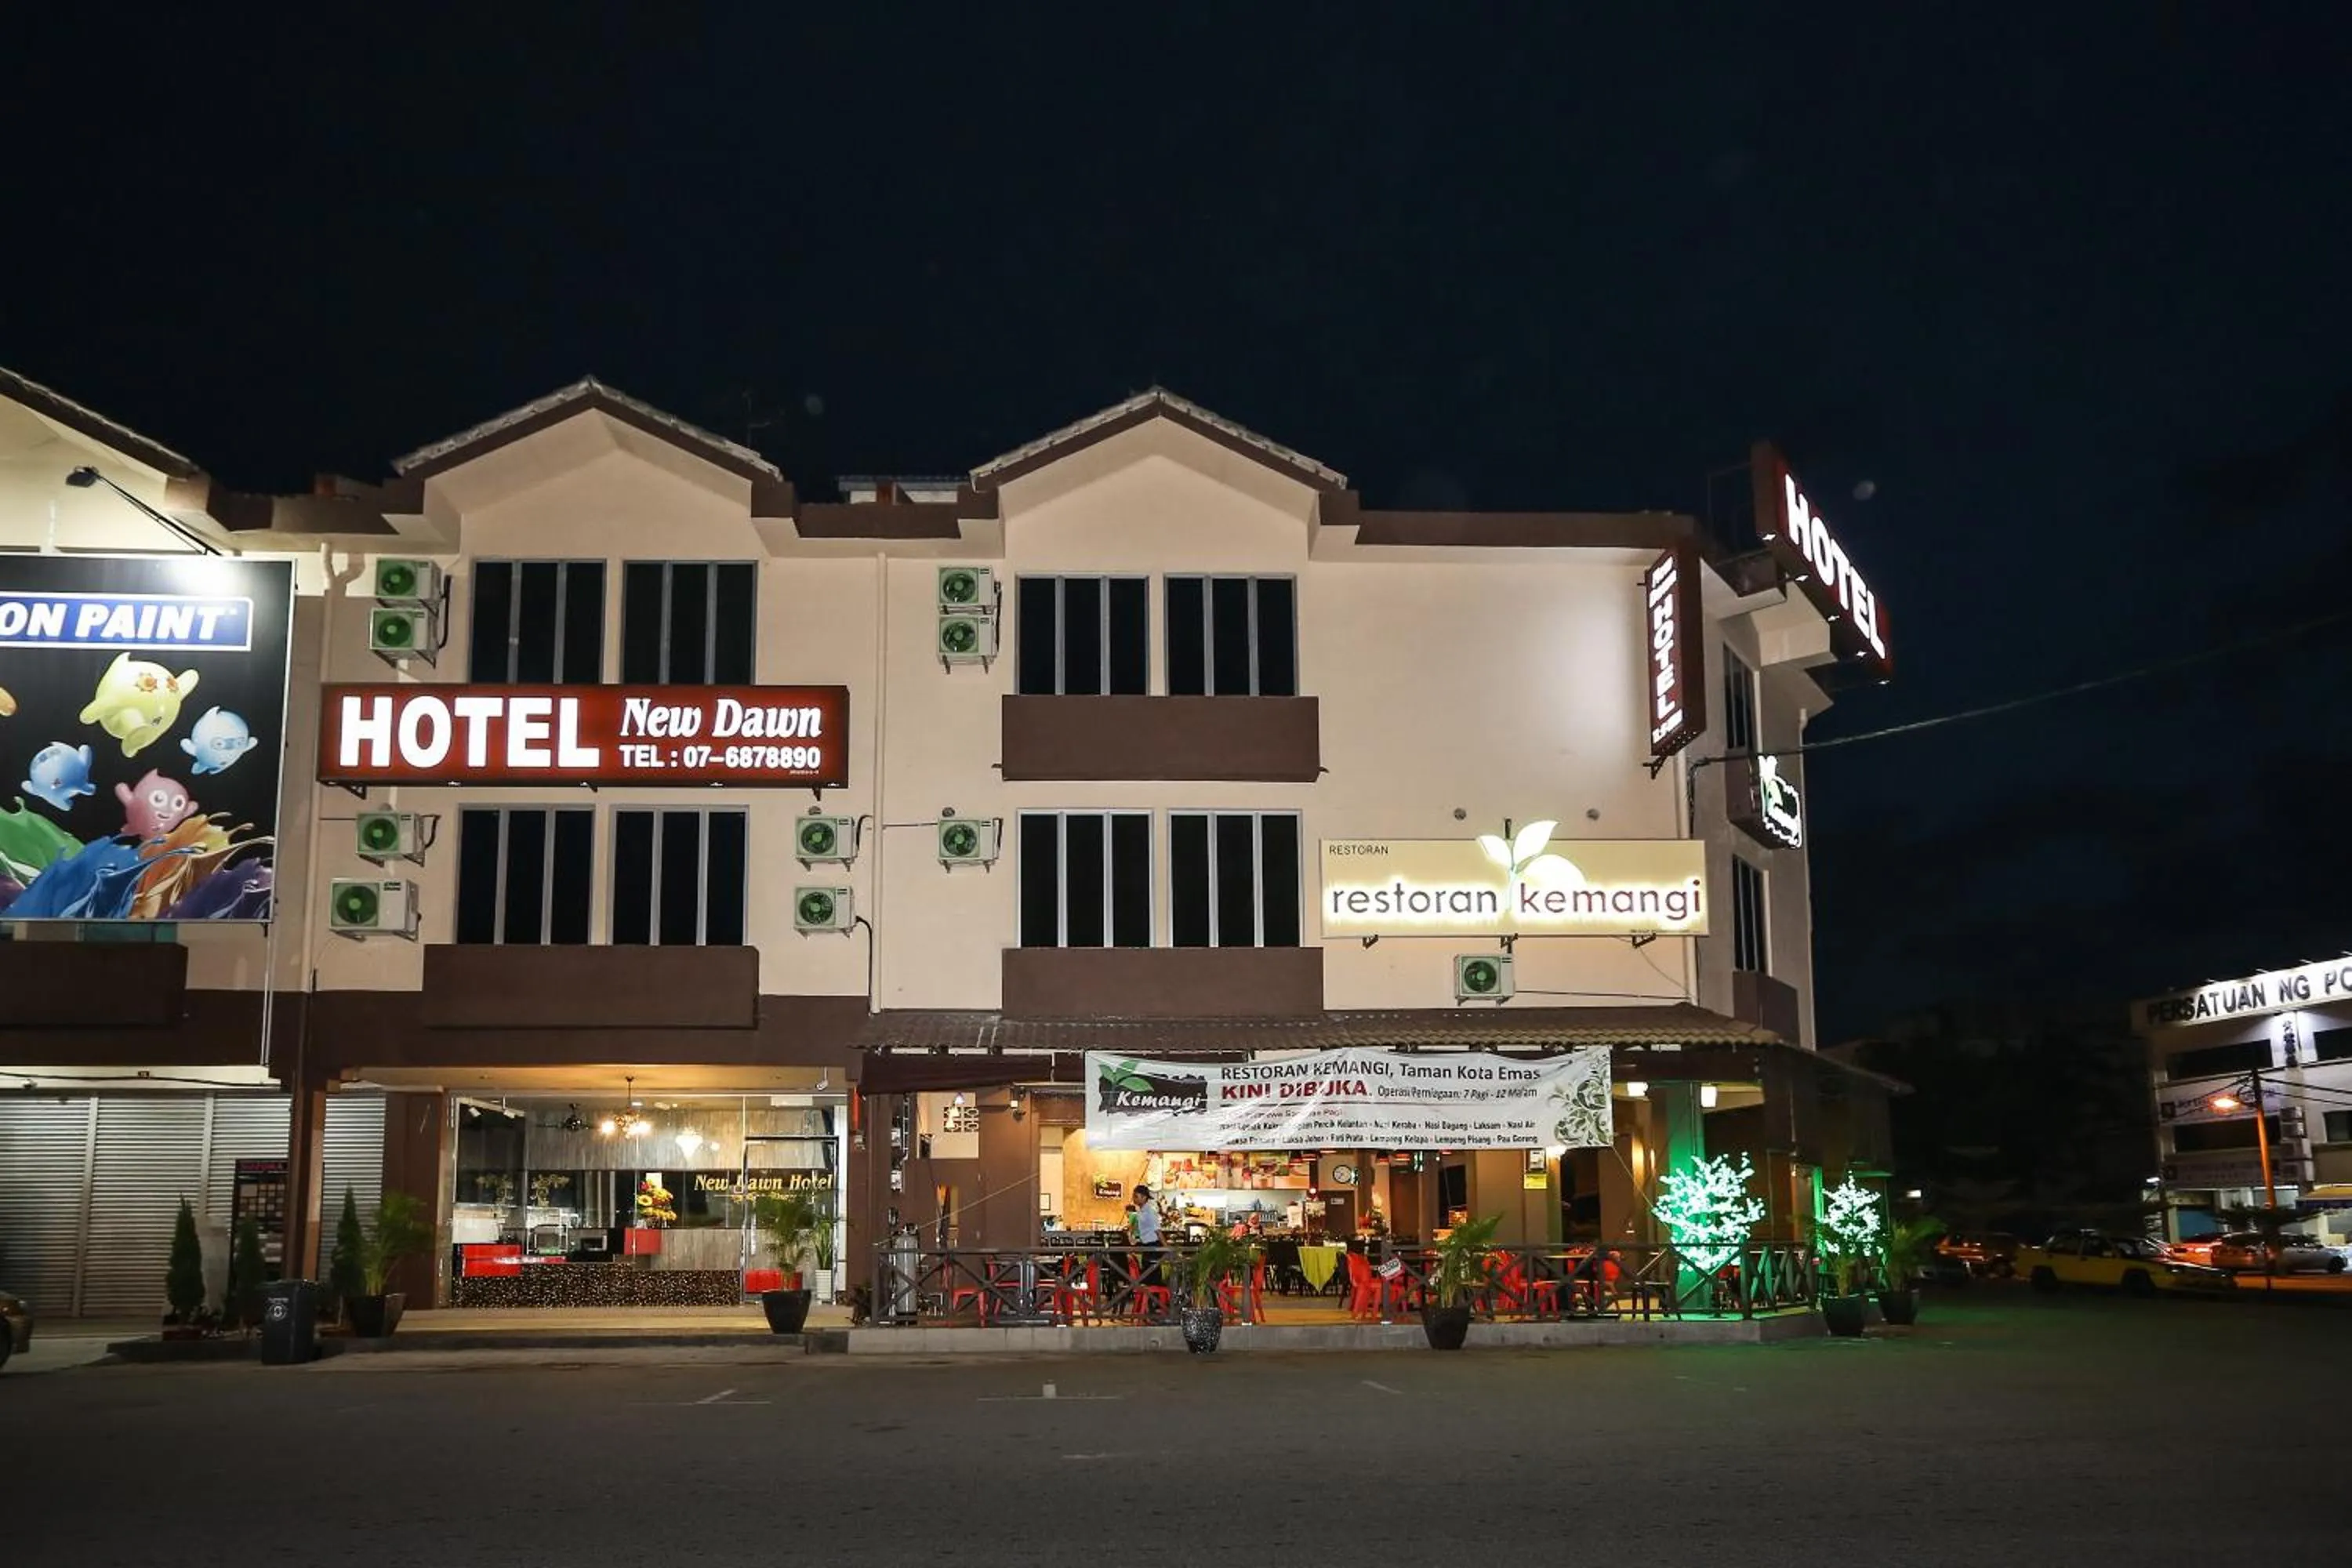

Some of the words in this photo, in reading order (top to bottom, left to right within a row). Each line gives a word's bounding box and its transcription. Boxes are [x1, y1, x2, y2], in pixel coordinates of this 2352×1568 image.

[1785, 474, 1886, 659] HOTEL
[74, 603, 226, 640] PAINT
[1653, 593, 1675, 720] HOTEL
[339, 695, 600, 769] HOTEL
[619, 698, 701, 738] New
[713, 698, 822, 738] Dawn
[683, 746, 821, 768] 07-6878890
[1329, 845, 1388, 855] RESTORAN
[1333, 883, 1498, 914] restoran
[1520, 879, 1700, 920] kemangi
[2147, 982, 2266, 1024] PERSATUAN
[2279, 975, 2310, 1003] NG
[1221, 1064, 1308, 1080] RESTORAN
[1313, 1061, 1393, 1078] KEMANGI,
[1399, 1063, 1452, 1079] Taman
[1457, 1065, 1494, 1080] Kota
[1498, 1067, 1541, 1080] Emas
[1116, 1091, 1202, 1109] Kemangi
[1464, 1089, 1469, 1098] 7
[1471, 1089, 1490, 1101] Pagi
[1496, 1089, 1506, 1098] 12
[694, 1174, 728, 1191] New
[789, 1174, 833, 1191] Hotel
